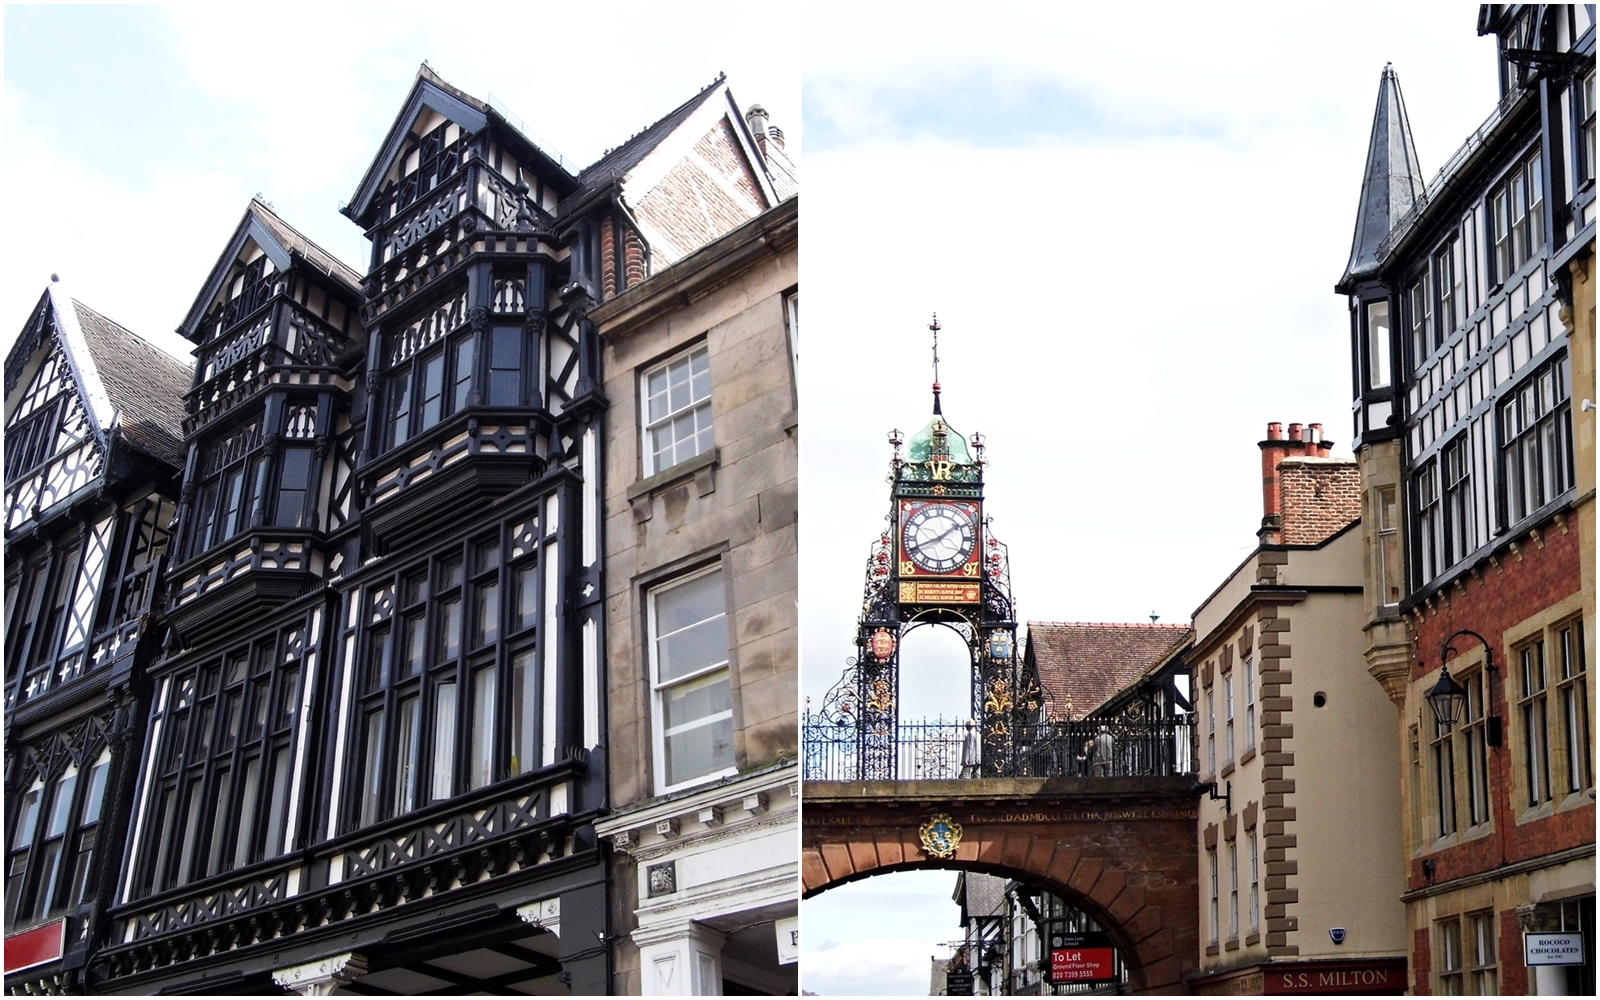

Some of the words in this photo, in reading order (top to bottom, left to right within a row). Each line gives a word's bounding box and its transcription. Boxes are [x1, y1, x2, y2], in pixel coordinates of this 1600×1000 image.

[931, 460, 951, 480] VR
[900, 561, 915, 575] 18
[963, 561, 979, 576] 97
[1104, 811, 1150, 819] BOSWELL
[1053, 952, 1065, 962] To
[1066, 952, 1081, 962] Let
[1079, 970, 1094, 978] 5555
[1283, 973, 1313, 988] S.S.
[1319, 970, 1388, 986] MILTON
